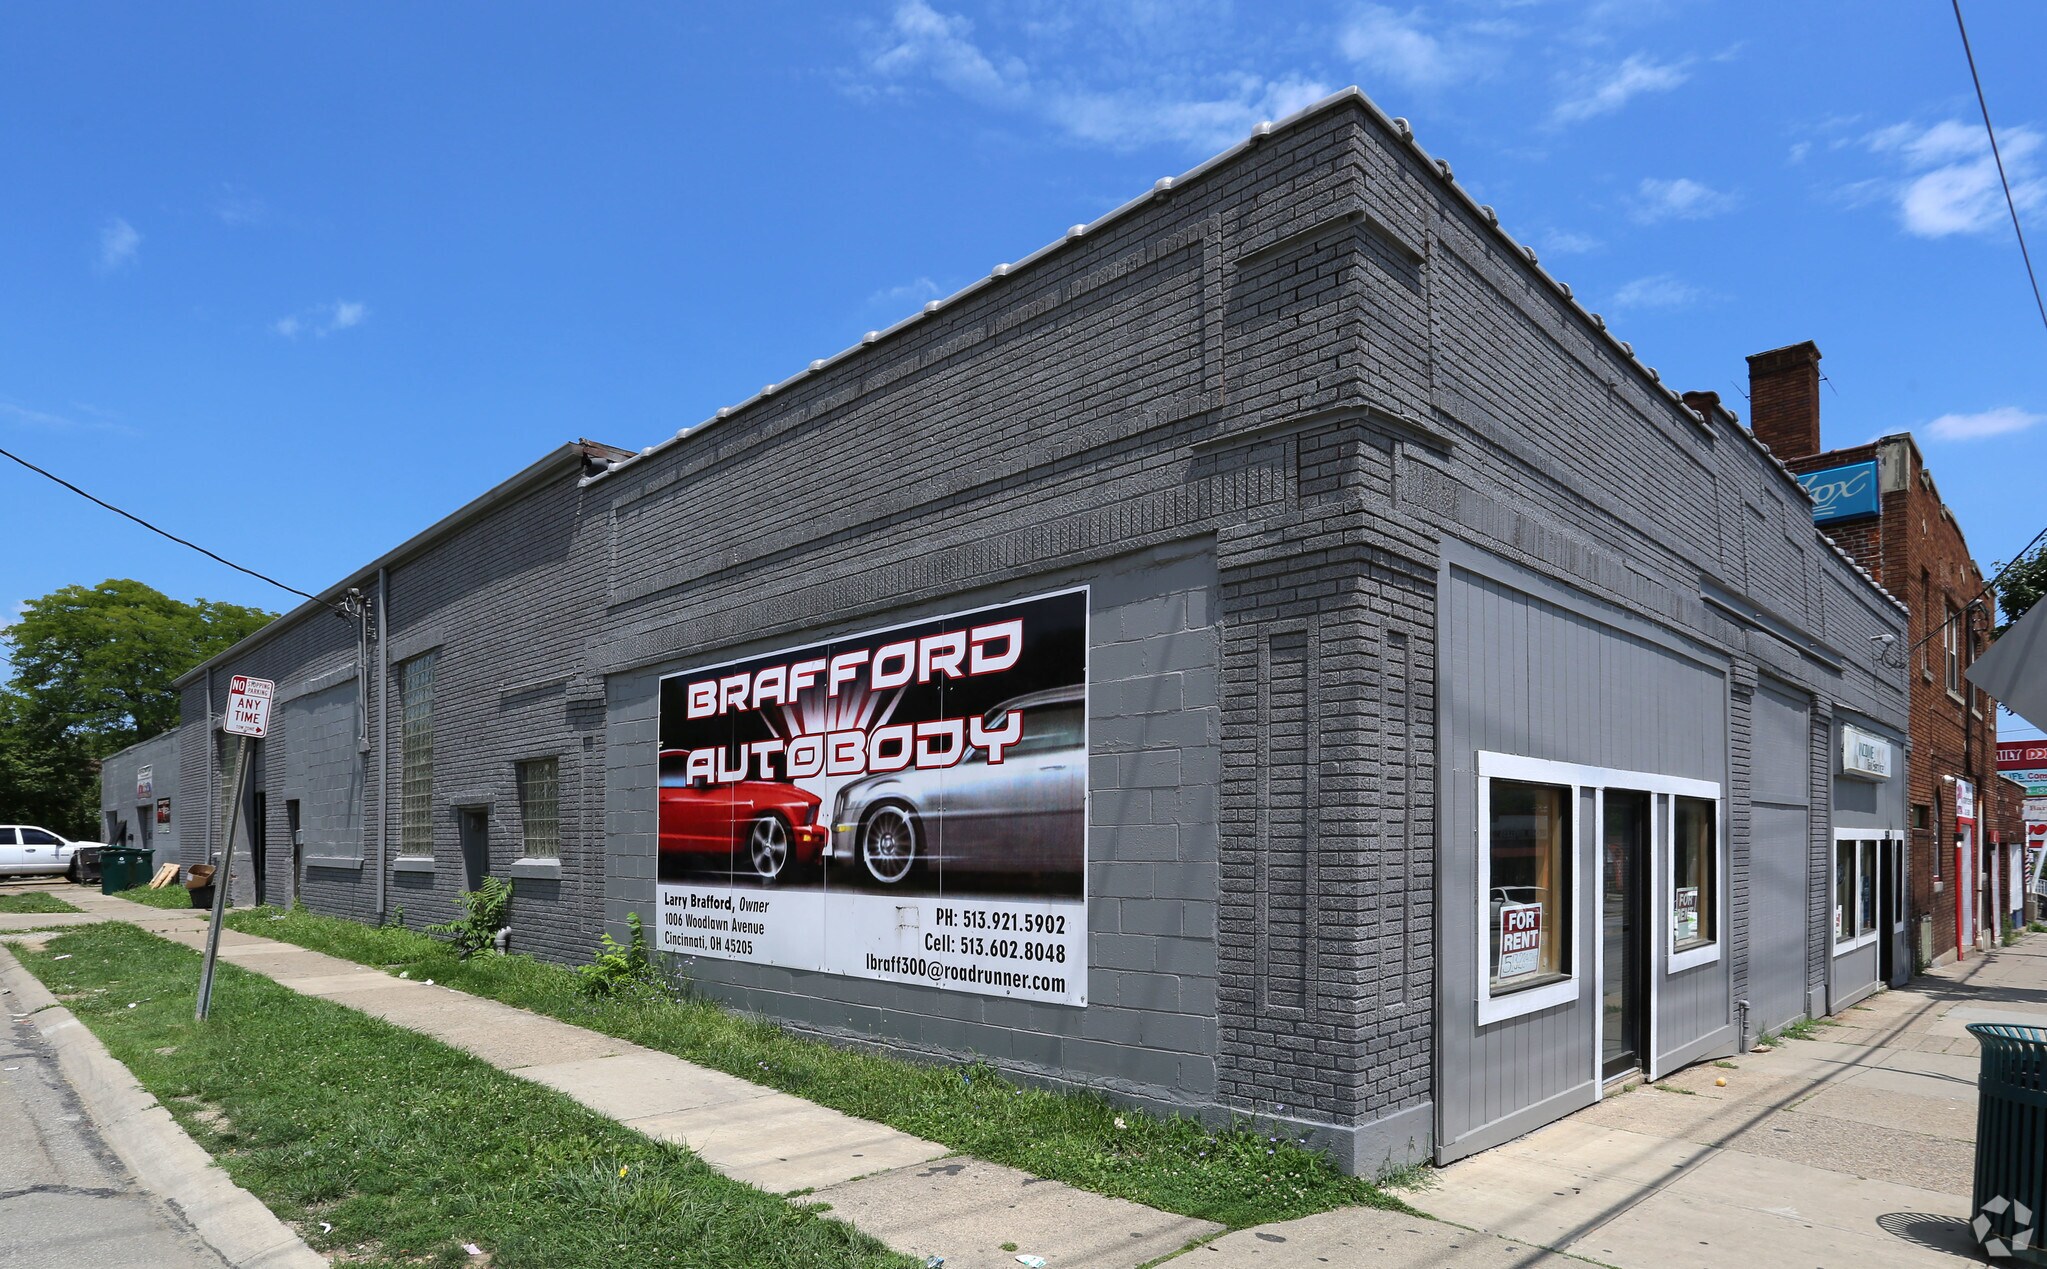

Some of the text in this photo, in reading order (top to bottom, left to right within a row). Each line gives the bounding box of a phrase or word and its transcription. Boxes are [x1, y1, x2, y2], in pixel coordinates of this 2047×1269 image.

[687, 617, 1024, 720] BRAFFORD
[232, 679, 246, 692] NO
[247, 687, 268, 696] PARKING
[237, 697, 261, 710] ANY
[235, 710, 260, 724] TIME
[686, 710, 1023, 786] AUTOBODY
[664, 892, 769, 913] Larry Brafford, Owner
[665, 912, 765, 935] 1006 Woodlawn Avenue
[936, 907, 1066, 935] PH: 513.921.5902
[1508, 911, 1535, 931] FOR
[664, 931, 753, 955] Cincinnati, OH 45205
[925, 932, 1066, 964] Cell: 513.602.8048
[1504, 929, 1539, 952] RENT
